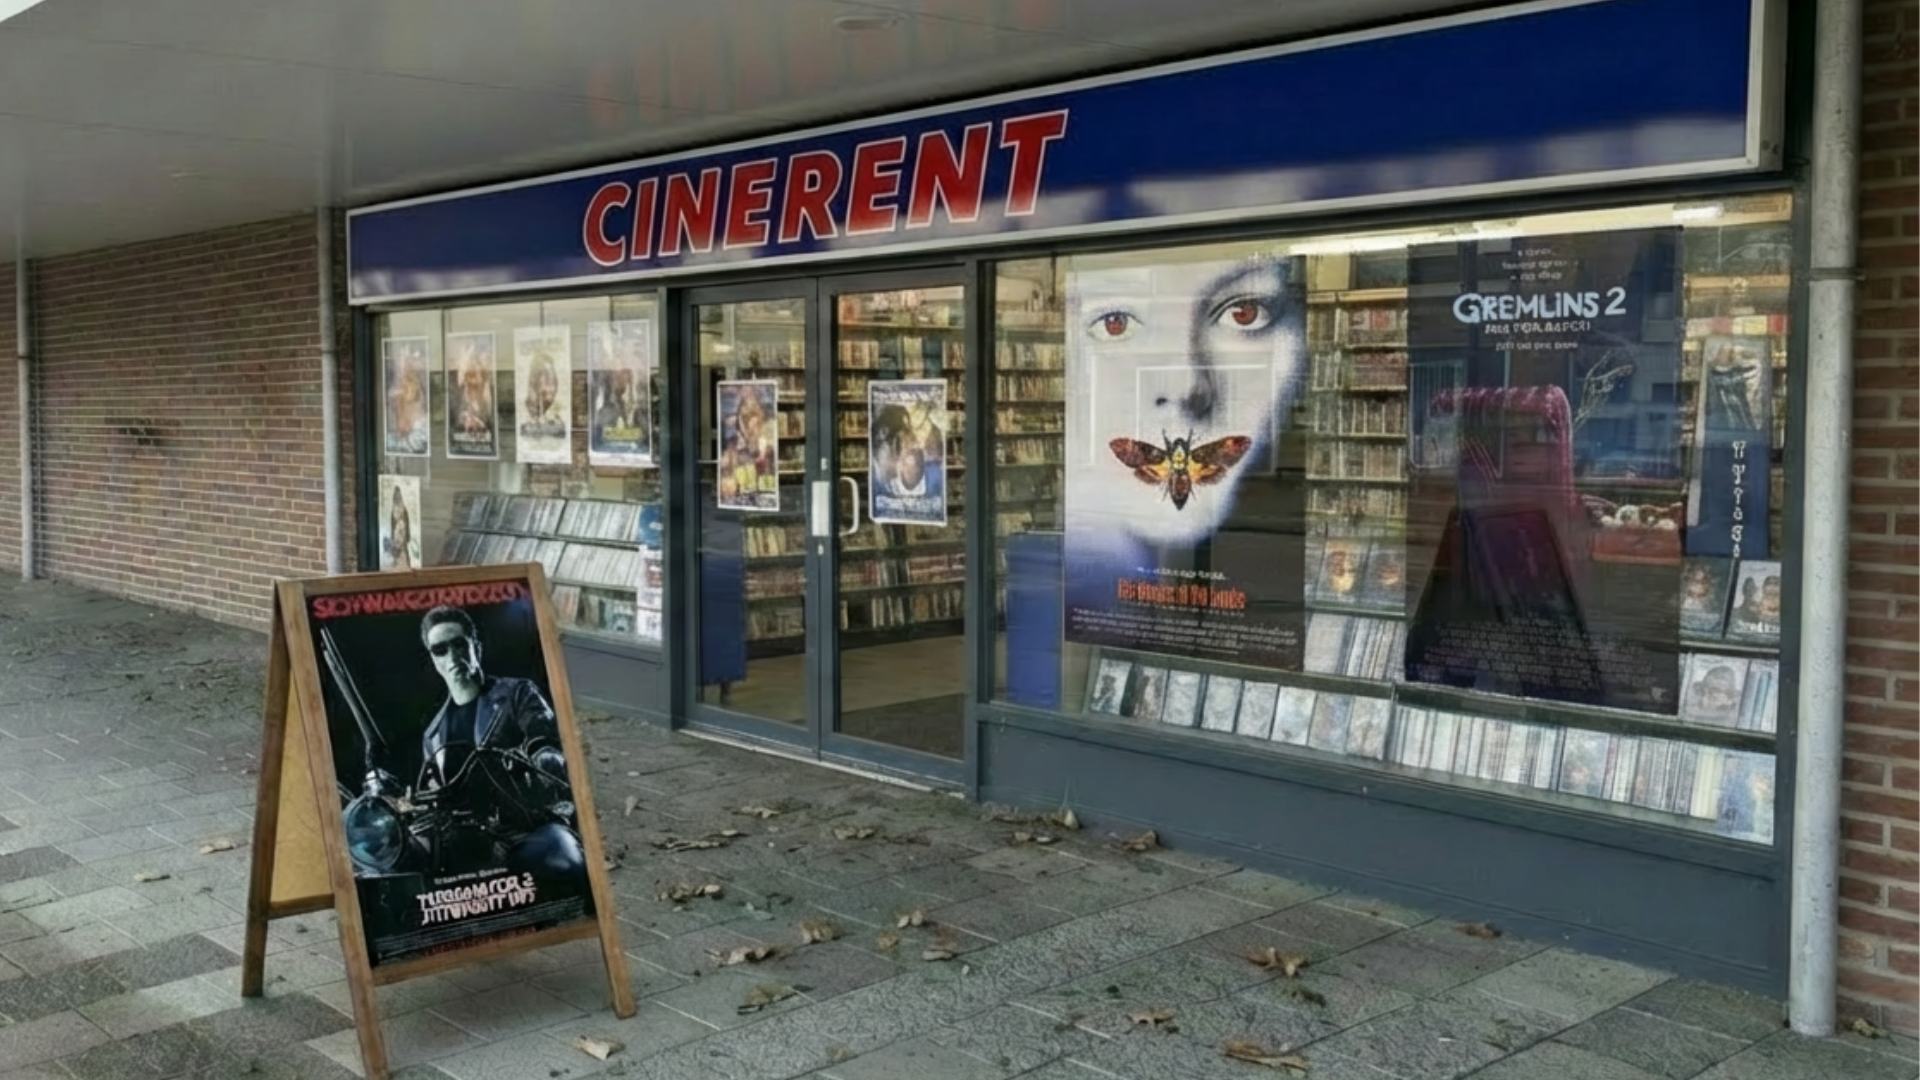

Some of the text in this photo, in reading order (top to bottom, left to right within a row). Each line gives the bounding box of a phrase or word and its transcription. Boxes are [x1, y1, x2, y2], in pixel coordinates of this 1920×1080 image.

[583, 109, 1069, 267] CINERENT
[1452, 286, 1627, 324] GREMLINS 2
